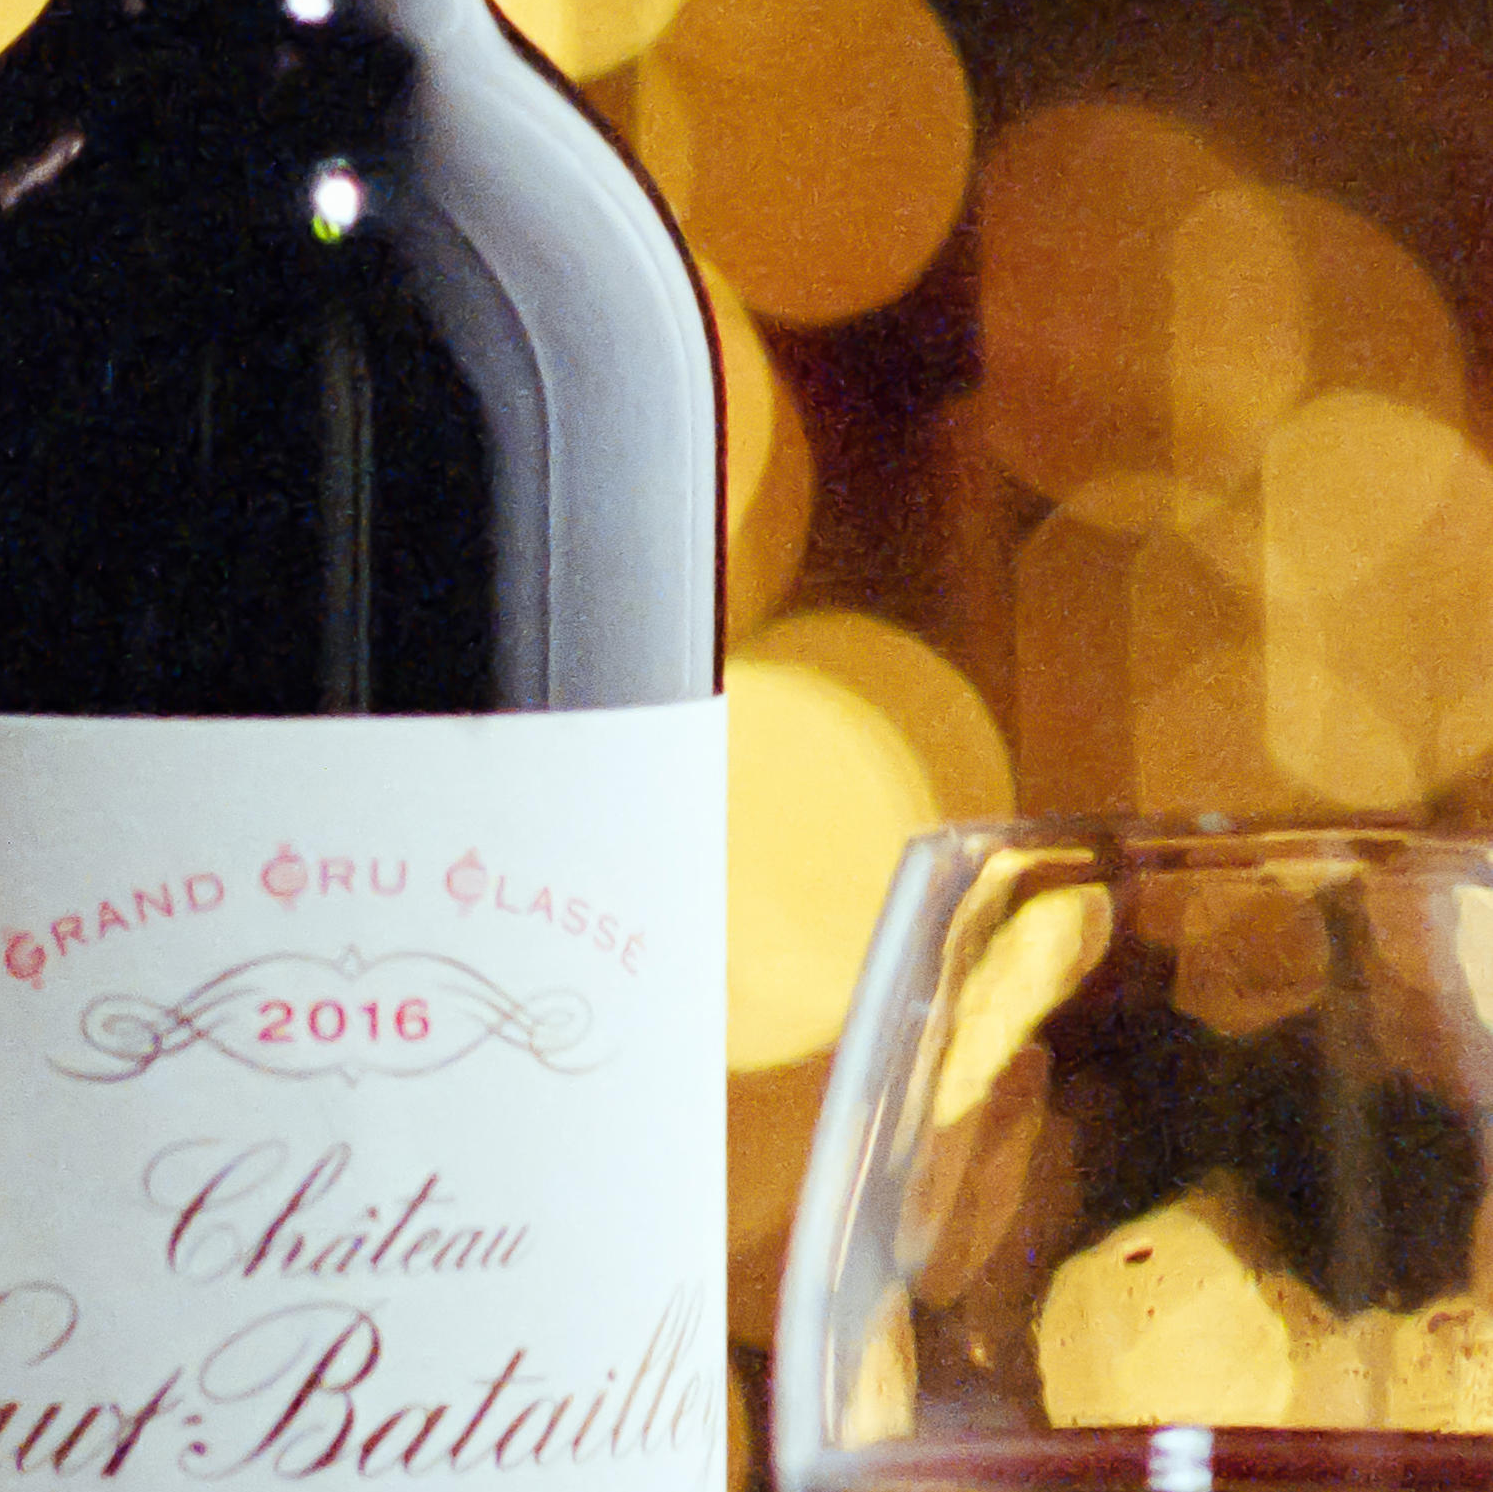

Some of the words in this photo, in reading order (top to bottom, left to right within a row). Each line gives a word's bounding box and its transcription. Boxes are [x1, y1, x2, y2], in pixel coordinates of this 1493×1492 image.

[3, 871, 227, 991] GRAND
[260, 843, 409, 910] CRU
[257, 997, 432, 1044] 2016
[141, 1137, 531, 1287] Château
